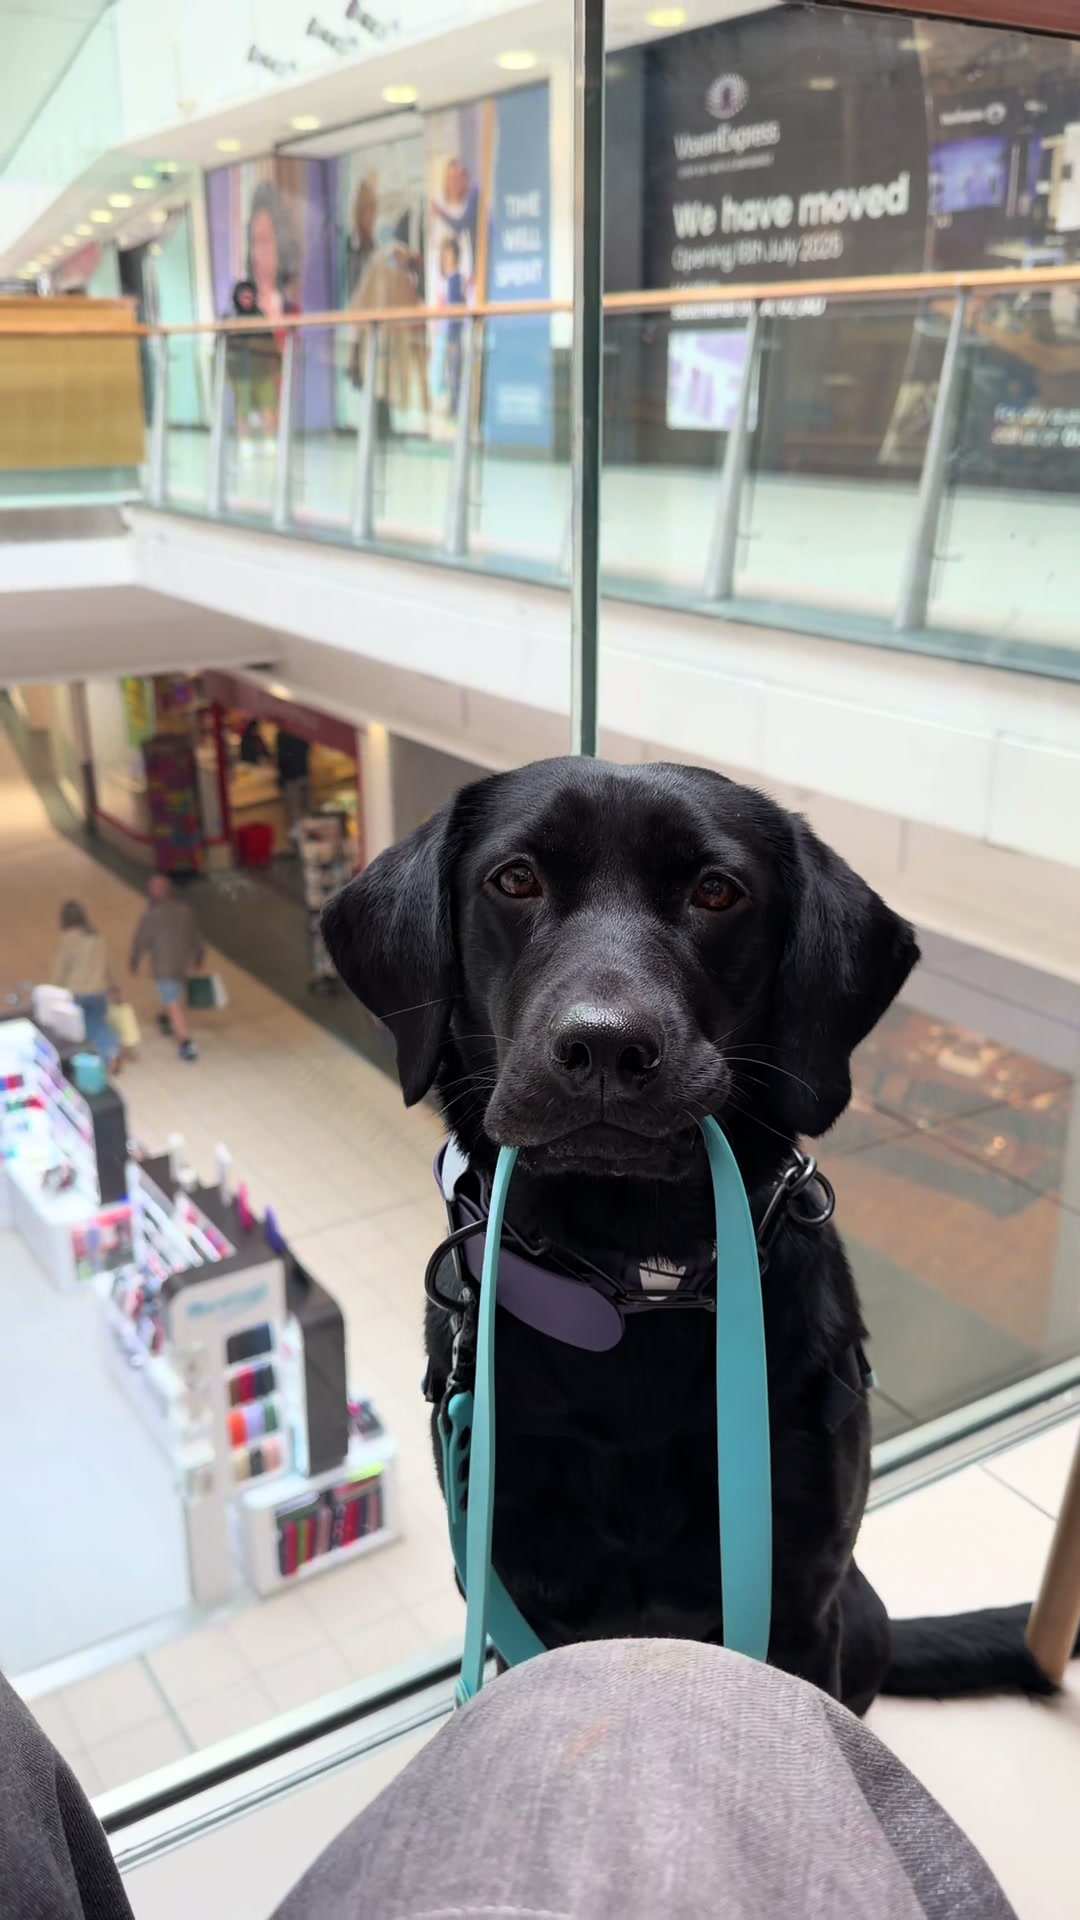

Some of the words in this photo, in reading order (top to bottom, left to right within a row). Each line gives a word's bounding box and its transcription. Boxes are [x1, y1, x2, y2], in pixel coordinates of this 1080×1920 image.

[673, 200, 718, 240] We
[721, 192, 795, 235] have
[798, 169, 911, 229] moved
